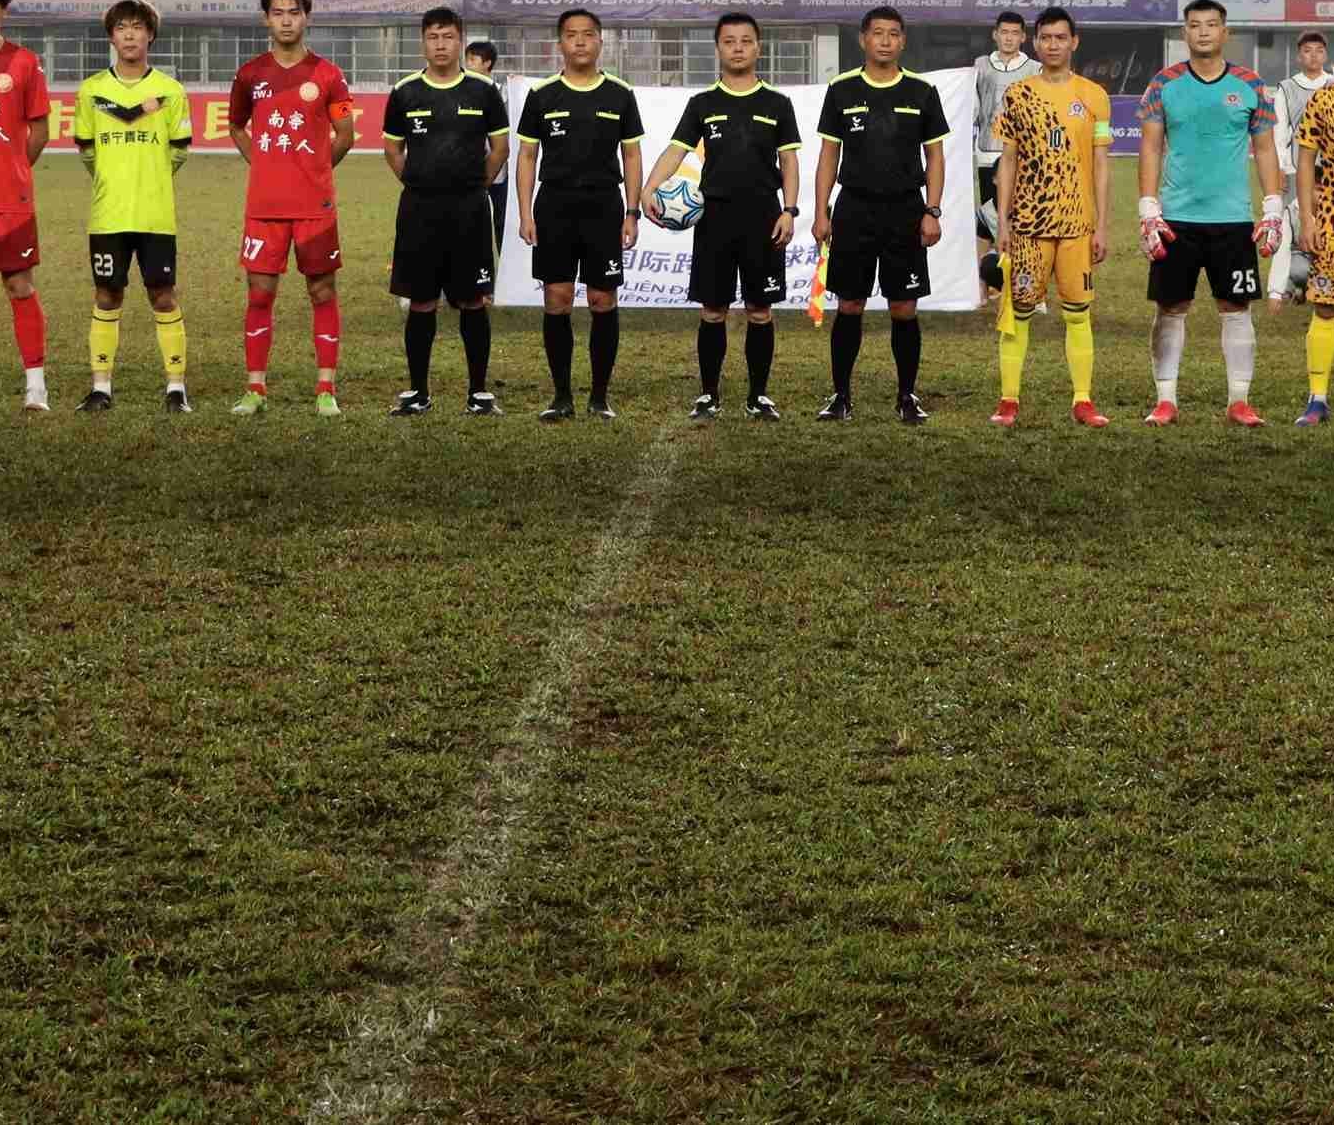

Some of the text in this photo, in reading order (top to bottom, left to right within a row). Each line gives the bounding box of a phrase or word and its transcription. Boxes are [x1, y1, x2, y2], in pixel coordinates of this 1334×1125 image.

[259, 132, 314, 153] 青年人
[243, 235, 265, 261] 27
[93, 252, 114, 277] 23
[1232, 269, 1257, 294] 25
